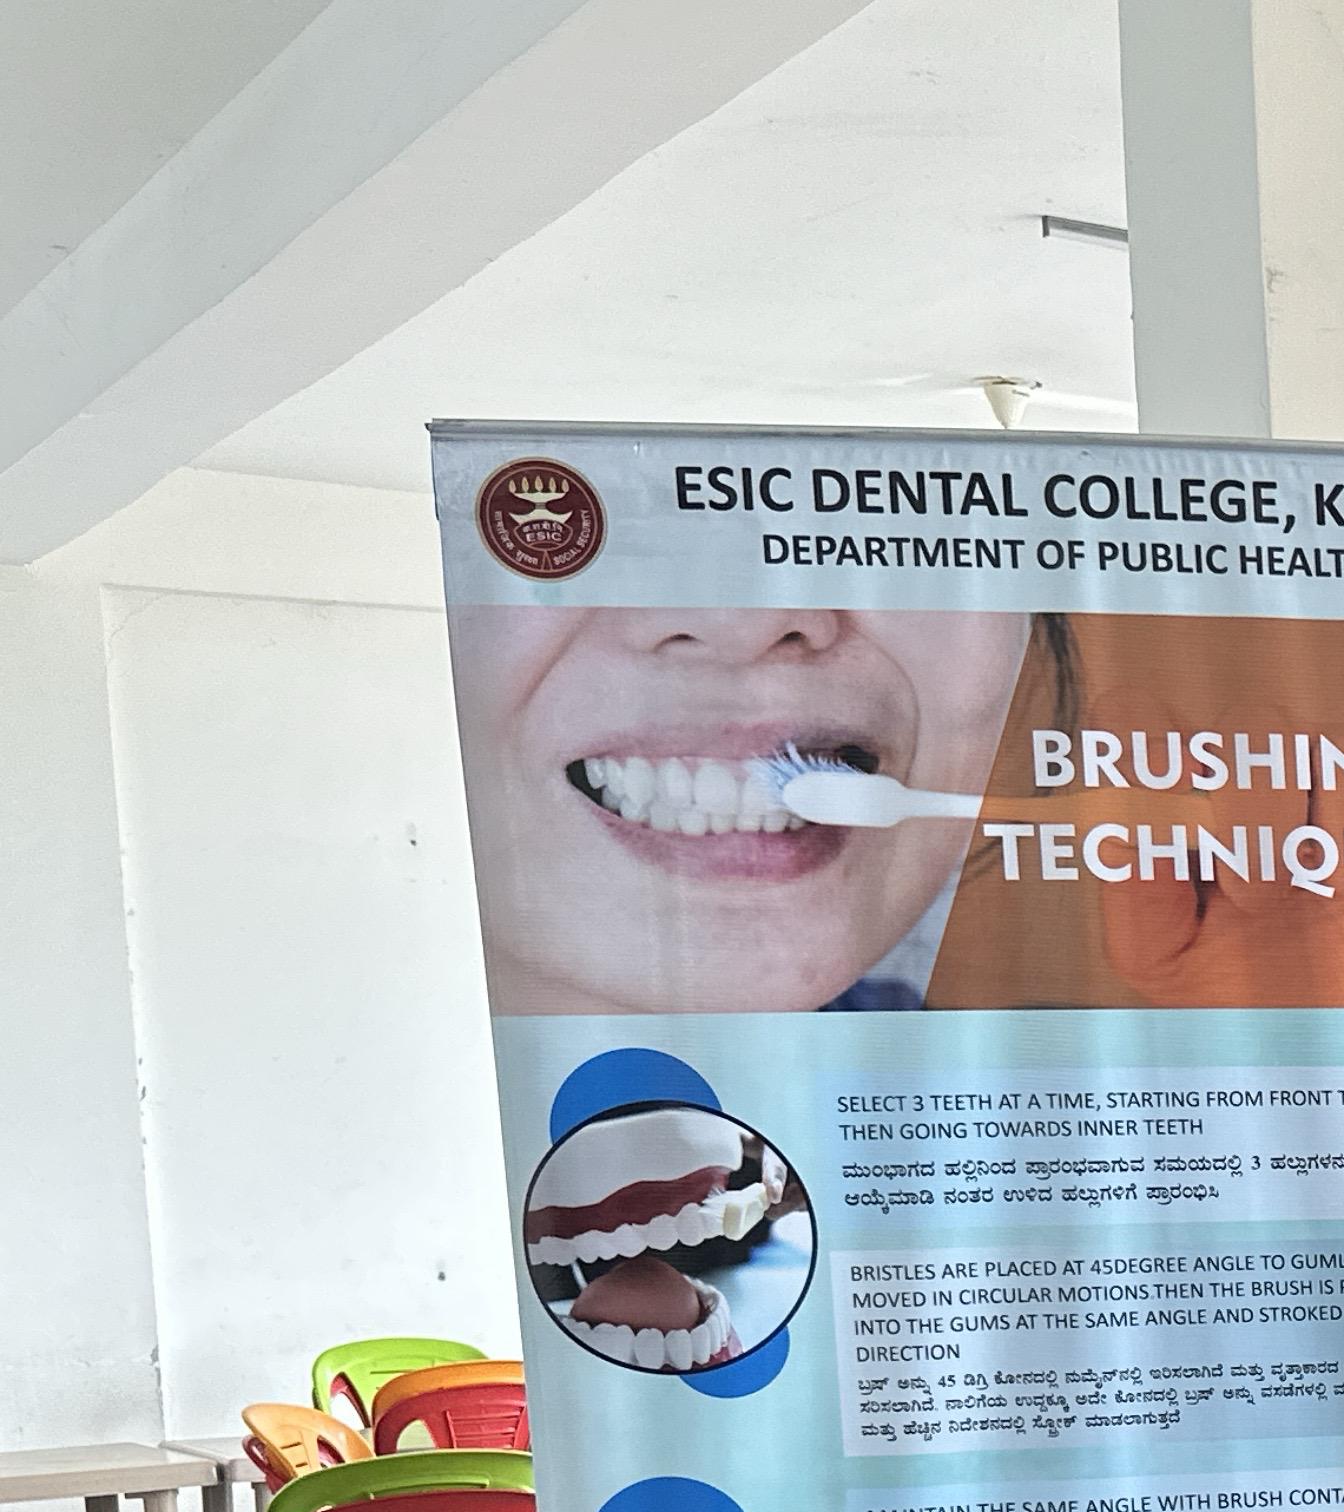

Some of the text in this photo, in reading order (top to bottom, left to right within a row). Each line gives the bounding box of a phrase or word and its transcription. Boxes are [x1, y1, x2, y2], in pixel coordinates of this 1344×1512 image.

[675, 465, 794, 513] ESIC
[811, 467, 1029, 518] DENTAL
[1043, 473, 1296, 535] COLLEGE,
[762, 533, 1026, 570] DEPARTMENT
[1036, 538, 1085, 571] OF
[1098, 540, 1229, 575] PUBLIC
[837, 1094, 907, 1113] SELECT
[912, 1094, 925, 1113] 3
[929, 1093, 993, 1112] TEETH
[998, 1092, 1022, 1111] AT
[1027, 1092, 1042, 1110] A
[1045, 1091, 1101, 1112] TIME,
[1106, 1090, 1200, 1109] STARTING
[1206, 1090, 1264, 1108] FROM
[1269, 1089, 1333, 1107] FRONT
[838, 1117, 1204, 1142] THEN GOING TOWARDS INNER TEETH
